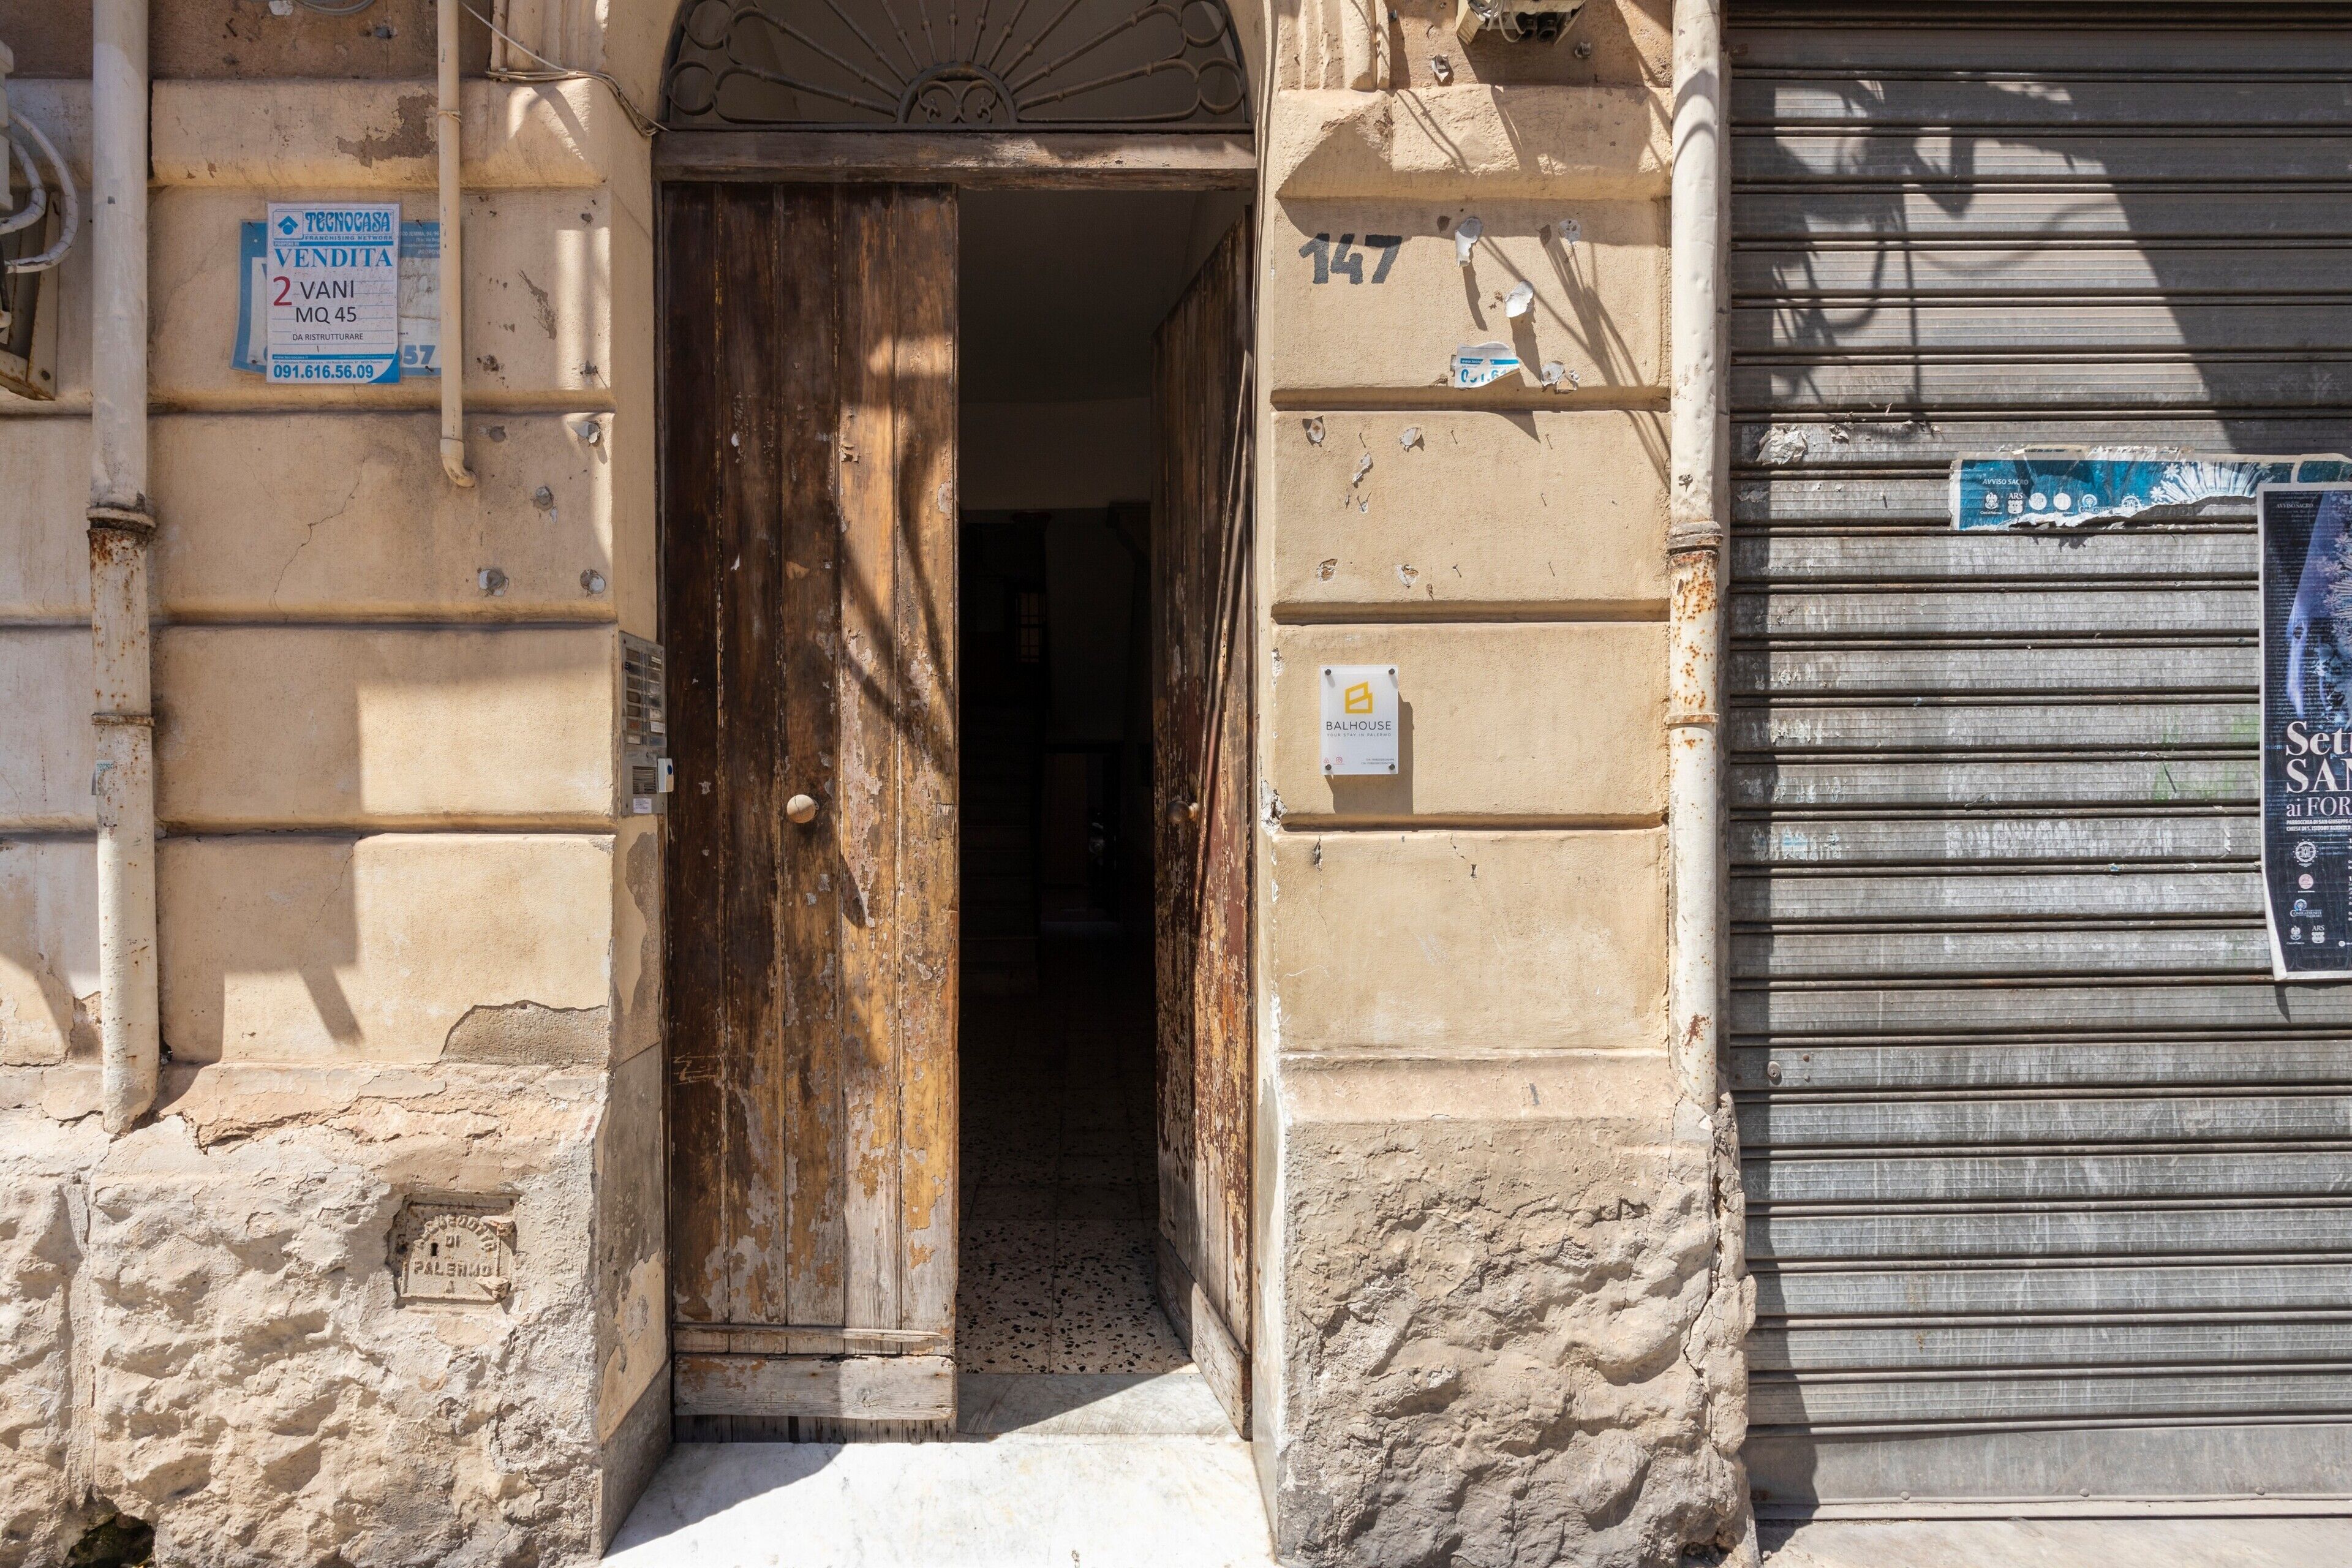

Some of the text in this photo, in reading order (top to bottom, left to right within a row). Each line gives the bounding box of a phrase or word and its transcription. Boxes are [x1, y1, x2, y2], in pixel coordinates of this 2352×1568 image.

[305, 212, 390, 232] TECNOCASA
[274, 248, 393, 268] VENDITA
[1299, 233, 1403, 284] 147
[273, 276, 354, 306] 2 VANI
[296, 307, 356, 324] MQ 45
[273, 364, 374, 379] 091.616.56.09
[1326, 721, 1392, 730] BALHOUSE
[2286, 798, 2302, 816] ai
[445, 1235, 460, 1248] DI
[413, 1261, 492, 1277] PALERMO
